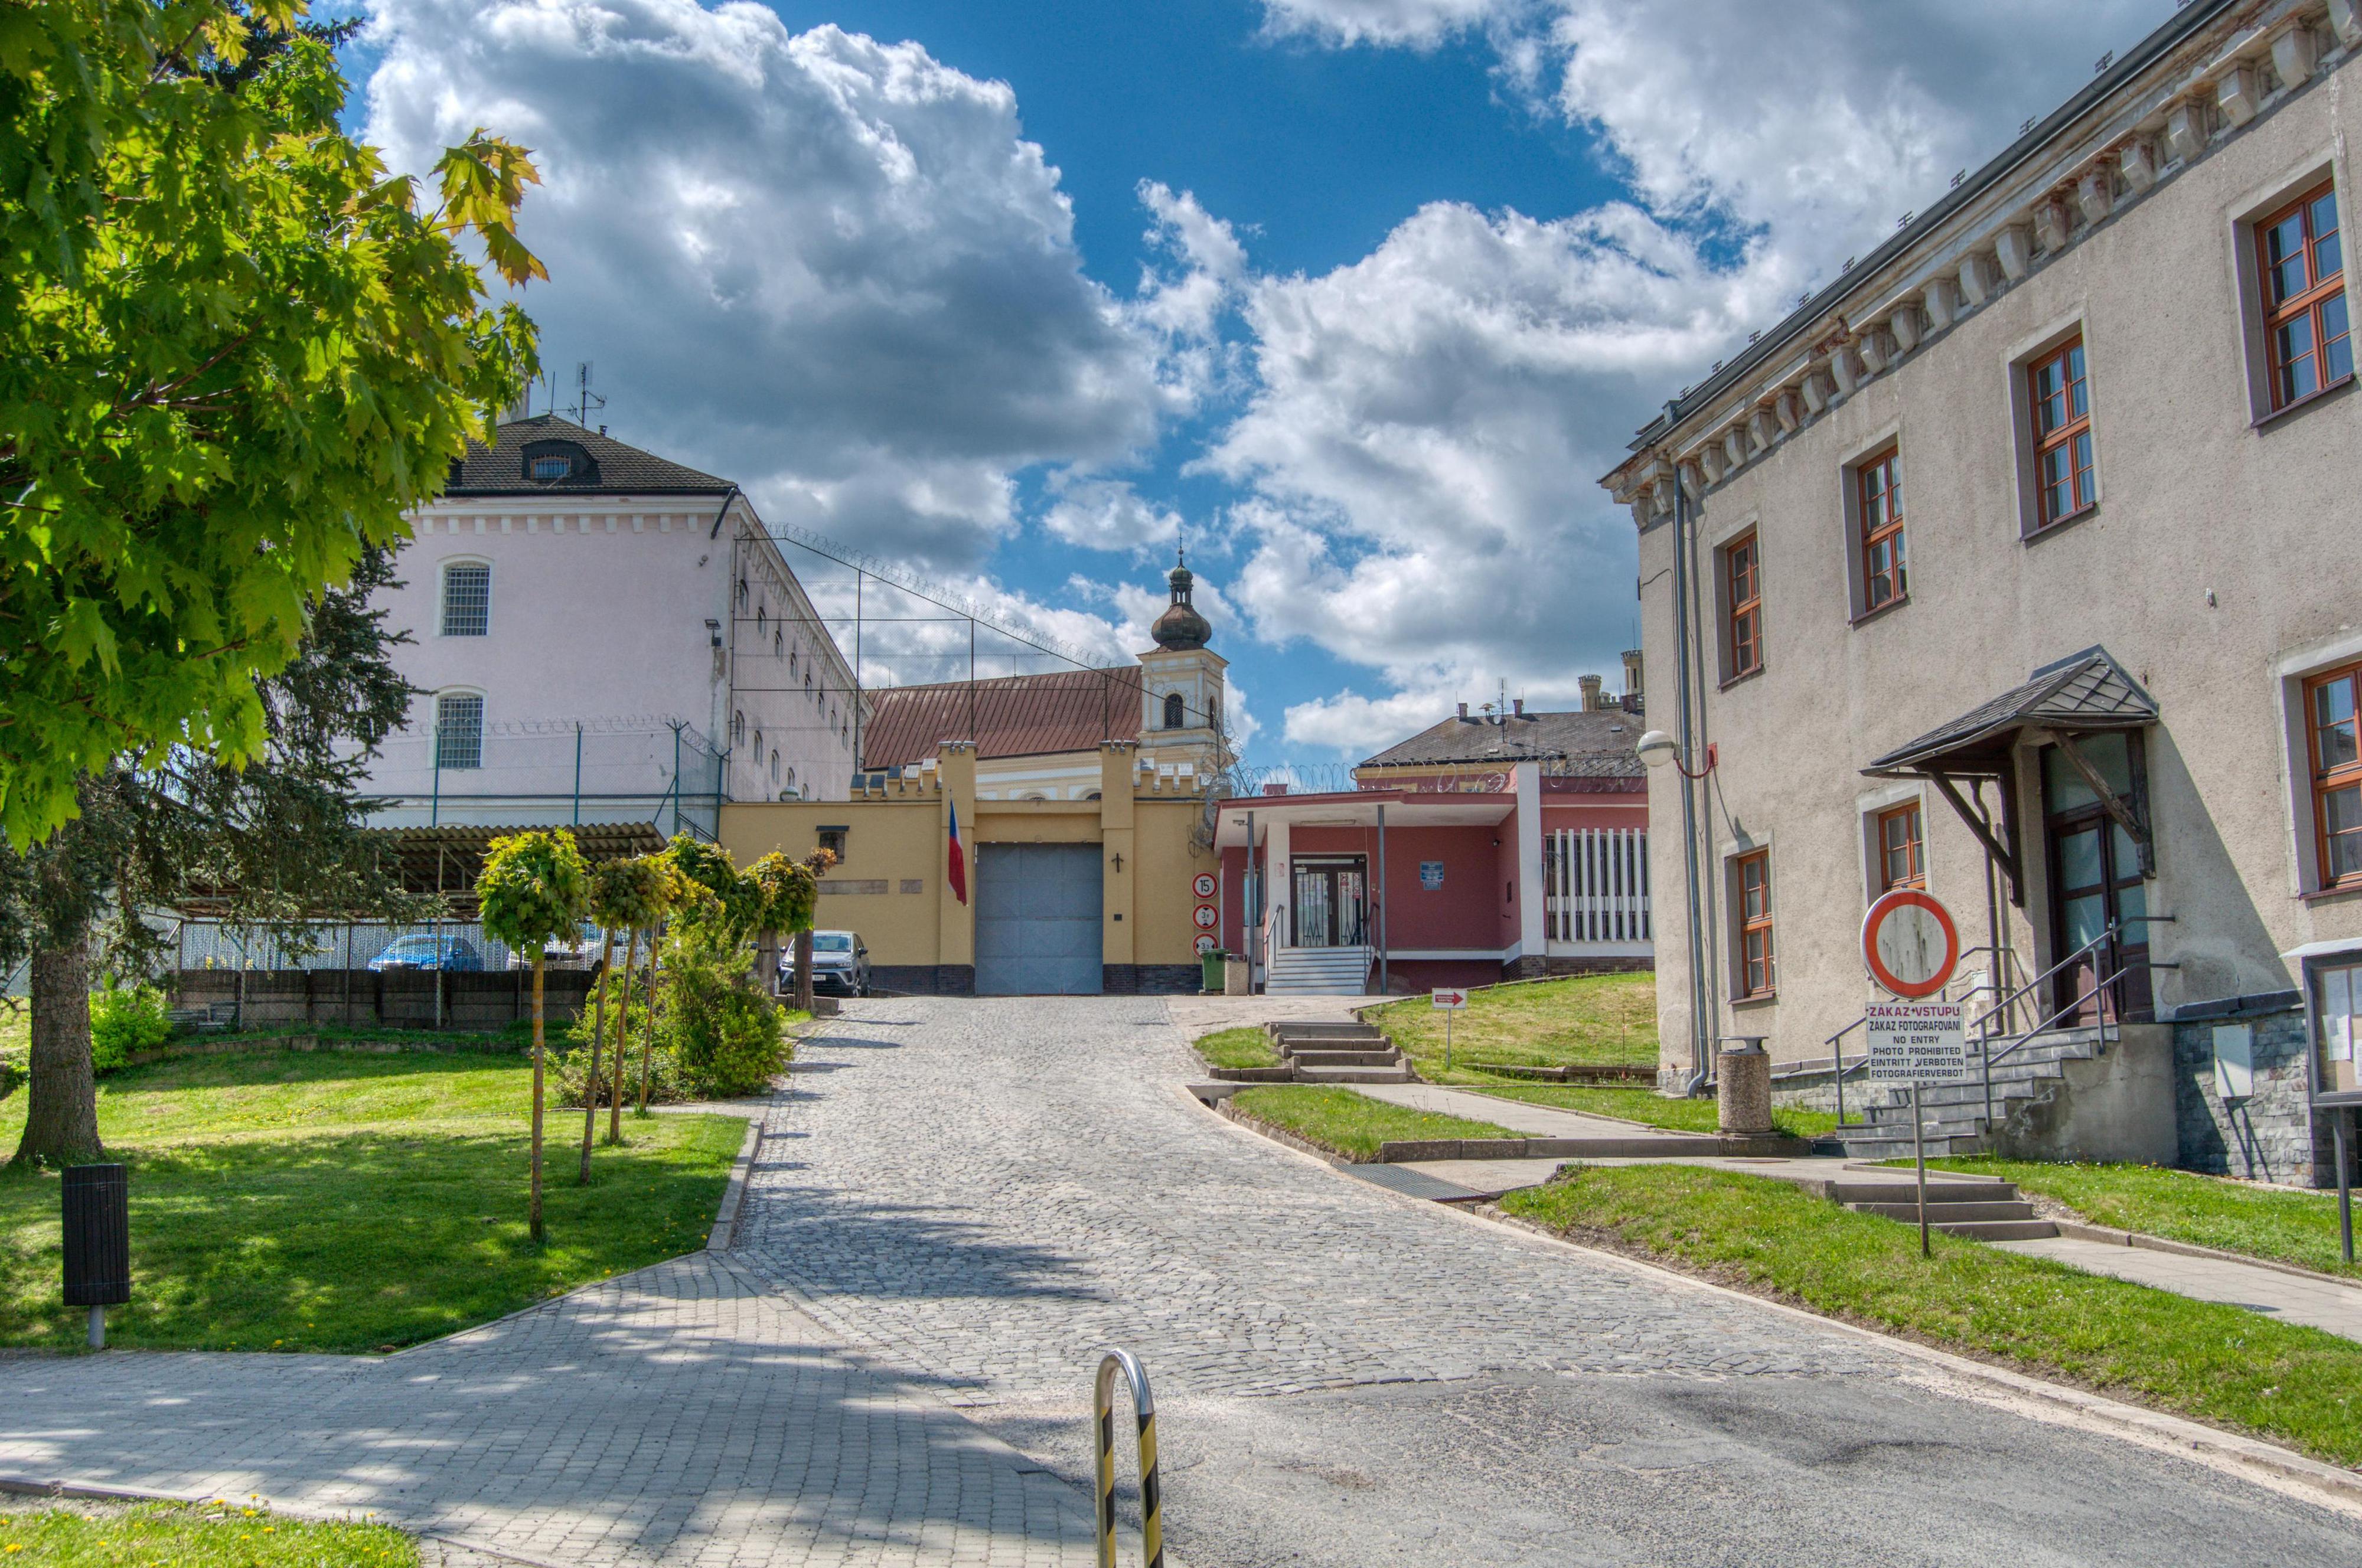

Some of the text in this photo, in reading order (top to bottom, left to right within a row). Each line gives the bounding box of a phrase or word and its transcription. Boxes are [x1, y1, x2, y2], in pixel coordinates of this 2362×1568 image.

[1200, 880, 1209, 892] 15
[1869, 1004, 1960, 1017] ZÁKAZ VSTUPU
[1869, 1018, 1960, 1031] ZÁKAZ FOTOGRAFOVÁNÍ
[1911, 1035, 1940, 1044] ENTRY
[1873, 1047, 1961, 1056] PHOTO PROHIBITED
[1871, 1058, 1964, 1067] EINTRITT VERBOTEN
[1871, 1069, 1964, 1078] FOTOGRAFIERVERBOT
